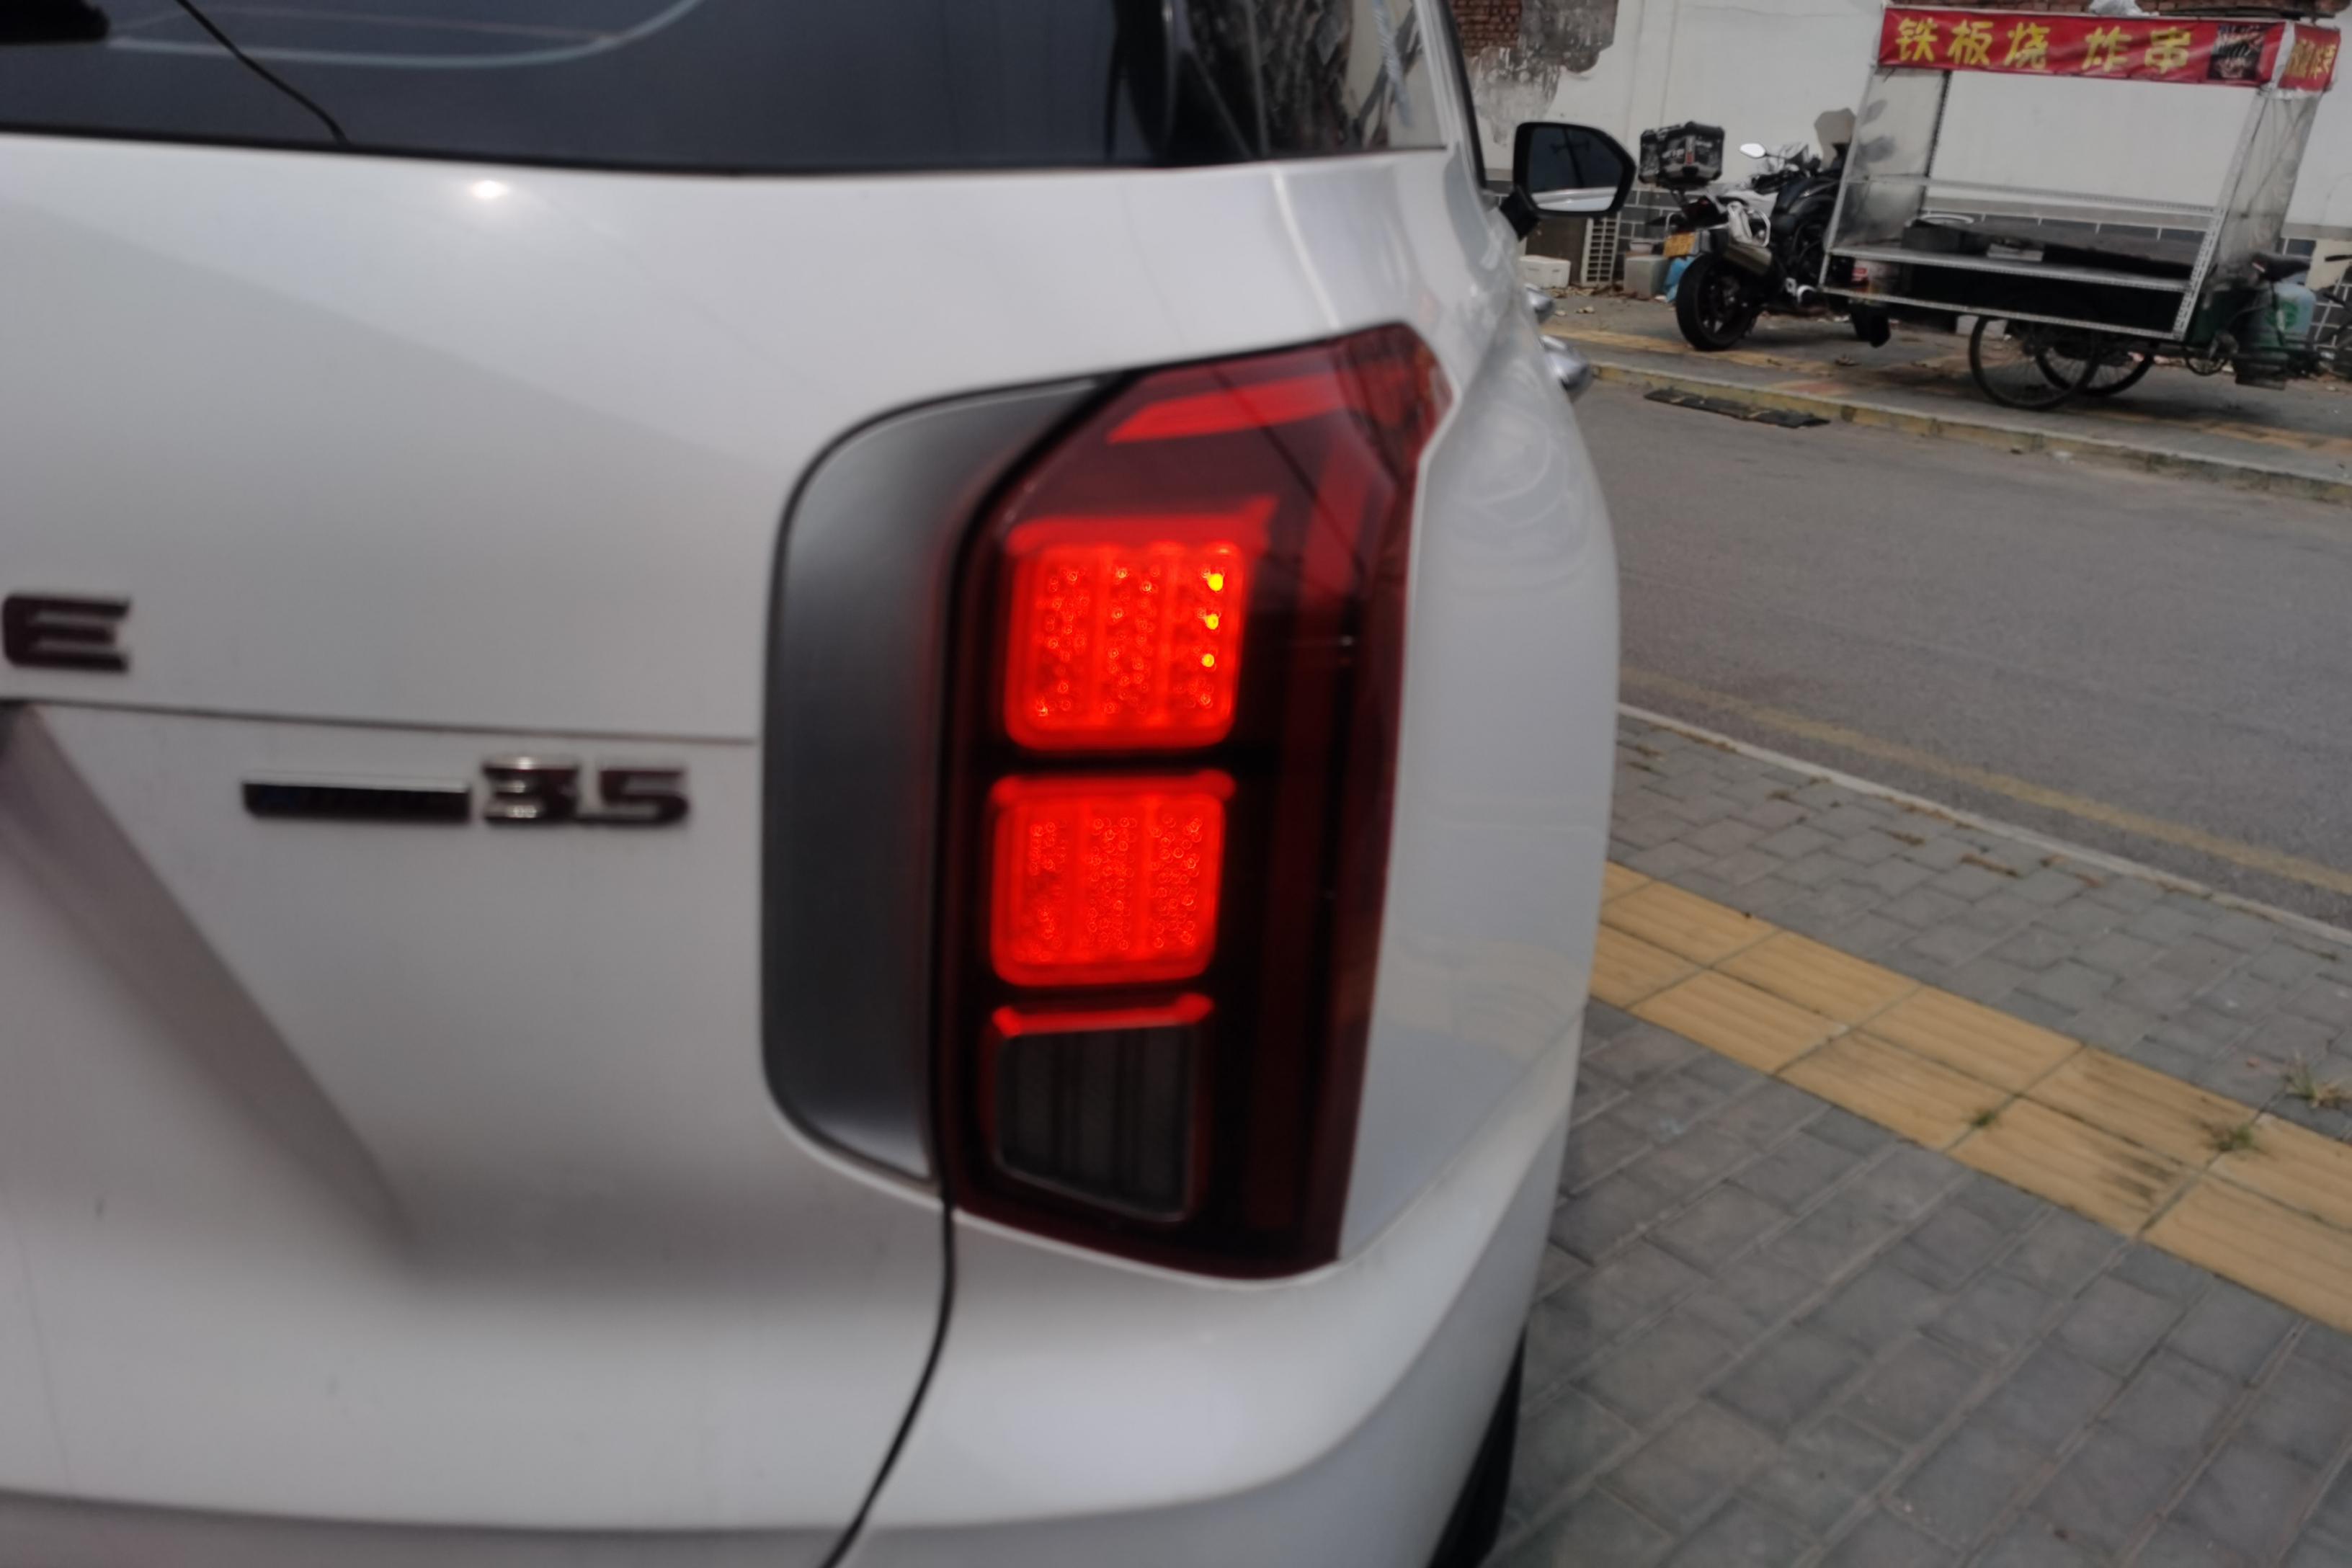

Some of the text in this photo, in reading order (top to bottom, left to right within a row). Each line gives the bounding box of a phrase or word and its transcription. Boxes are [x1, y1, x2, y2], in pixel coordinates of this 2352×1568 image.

[1895, 17, 2050, 70] 铁板烧
[2, 594, 130, 674] E
